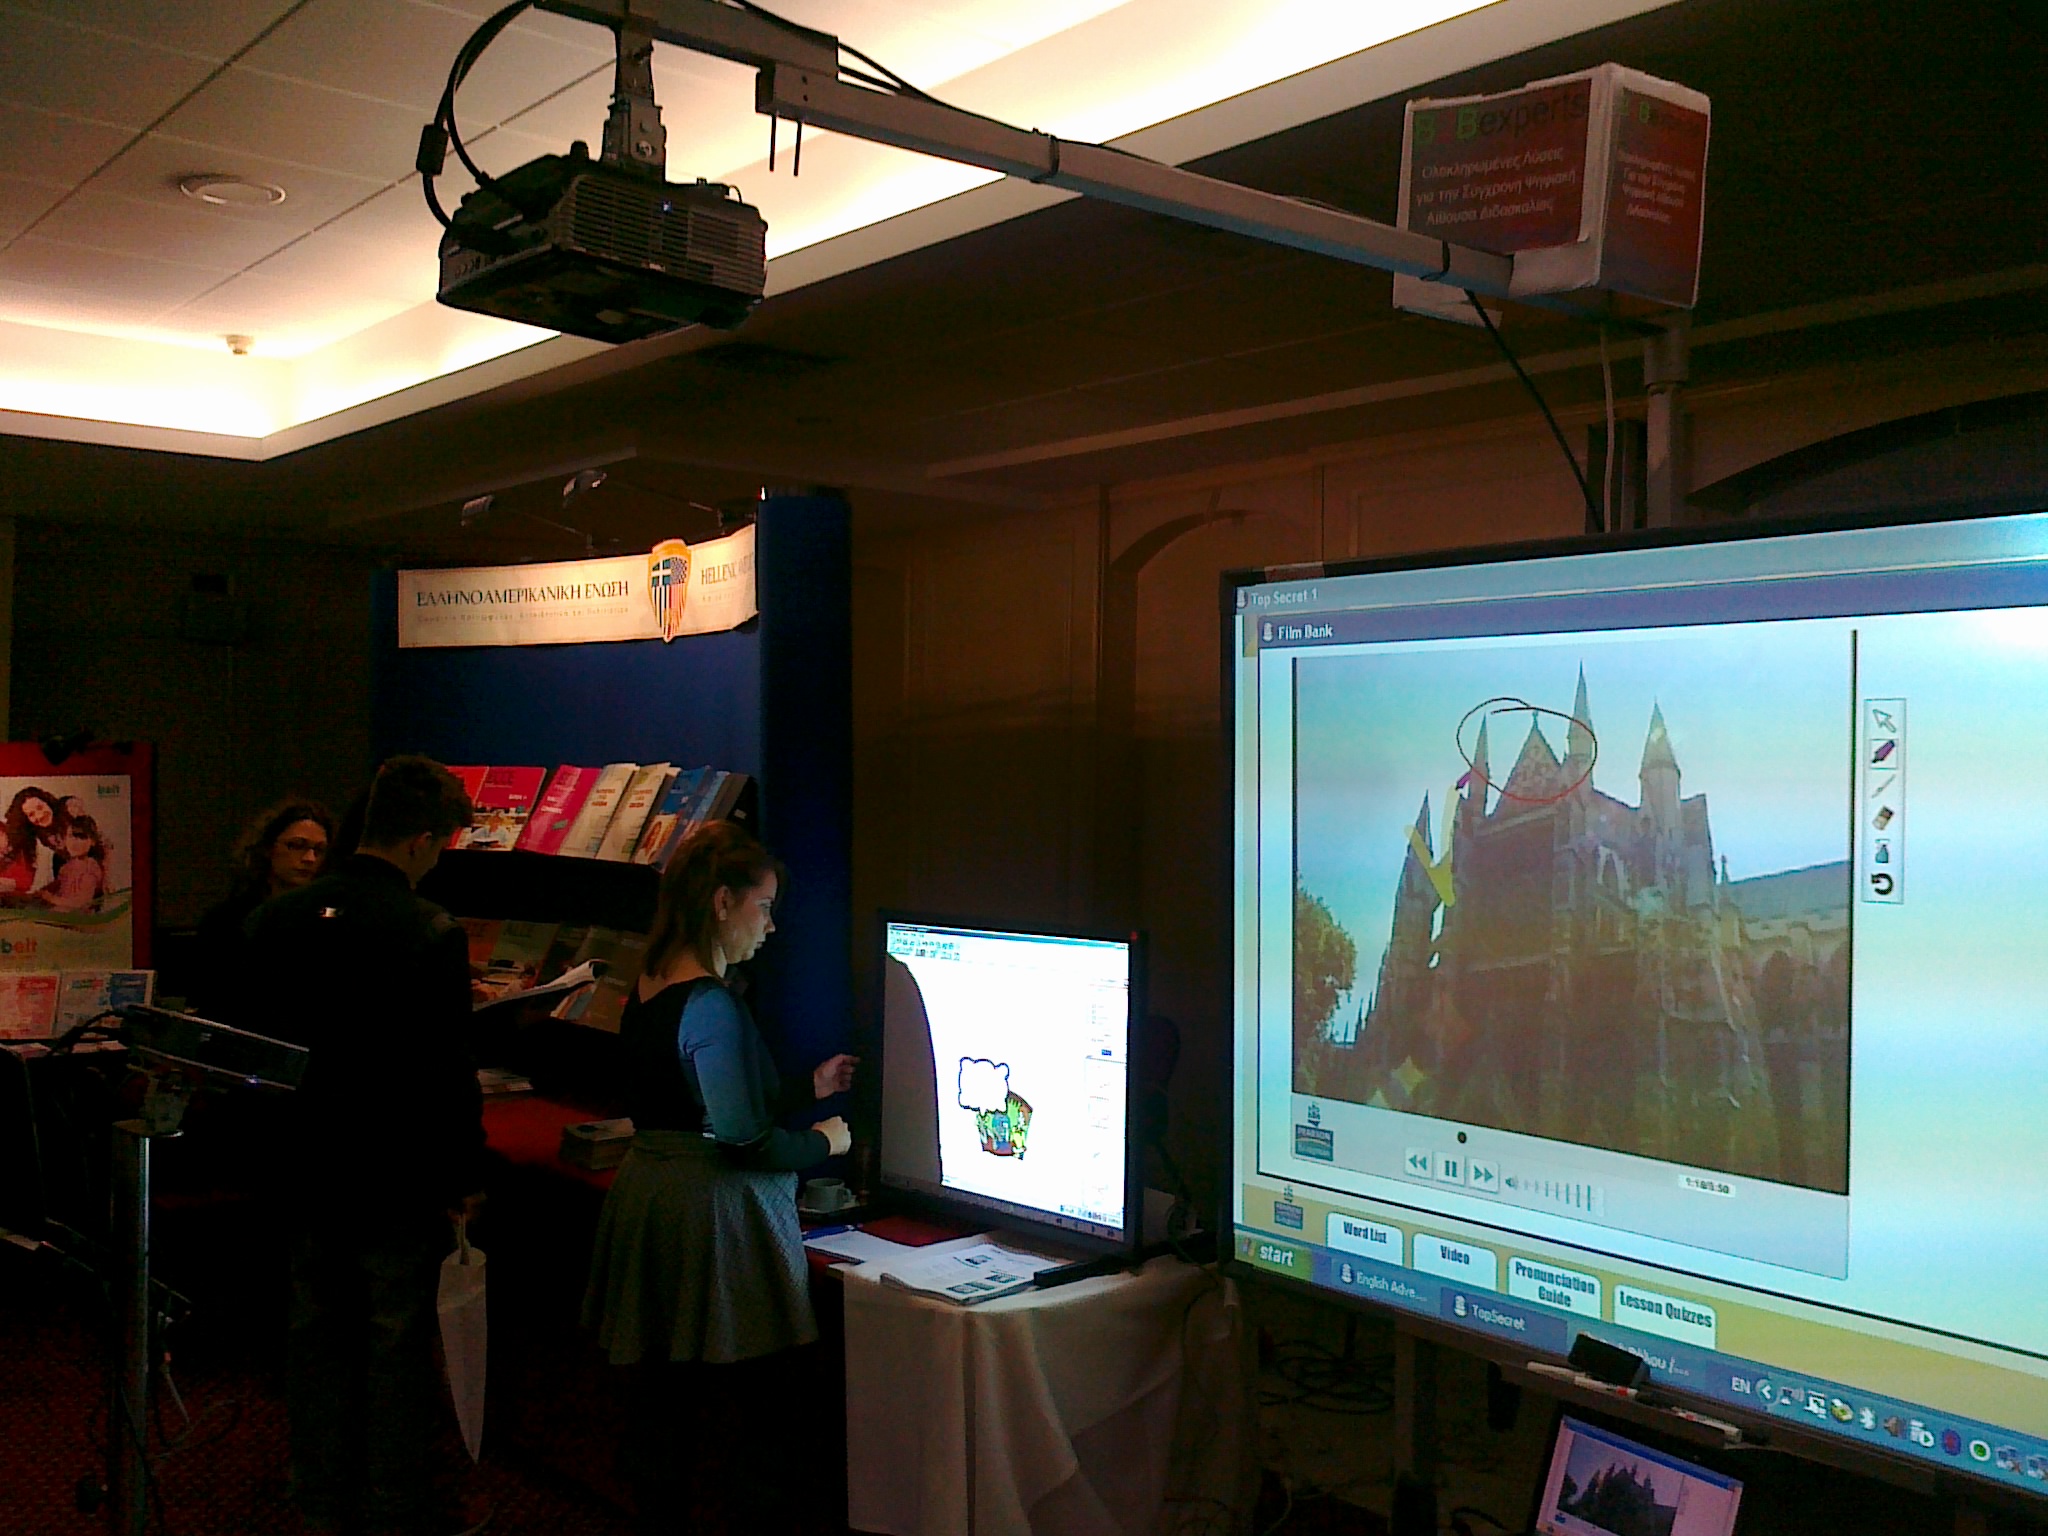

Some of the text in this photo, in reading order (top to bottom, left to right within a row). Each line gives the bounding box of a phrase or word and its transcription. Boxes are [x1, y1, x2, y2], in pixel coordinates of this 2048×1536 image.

[585, 580, 629, 599] ΕΝΩΣΗ
[1251, 587, 1318, 608] Top Secret 1
[1278, 622, 1334, 640] Film Bank
[1343, 1221, 1388, 1244] Word List
[1259, 1244, 1294, 1267] start
[1440, 1245, 1470, 1265] Video
[1356, 1272, 1389, 1293] English
[1515, 1261, 1596, 1295] Pronunciation
[1538, 1285, 1572, 1308] Guide
[1471, 1304, 1526, 1332] TopSecret
[1619, 1291, 1712, 1328] Lesson Quizzes
[1731, 1376, 1751, 1394] EN
